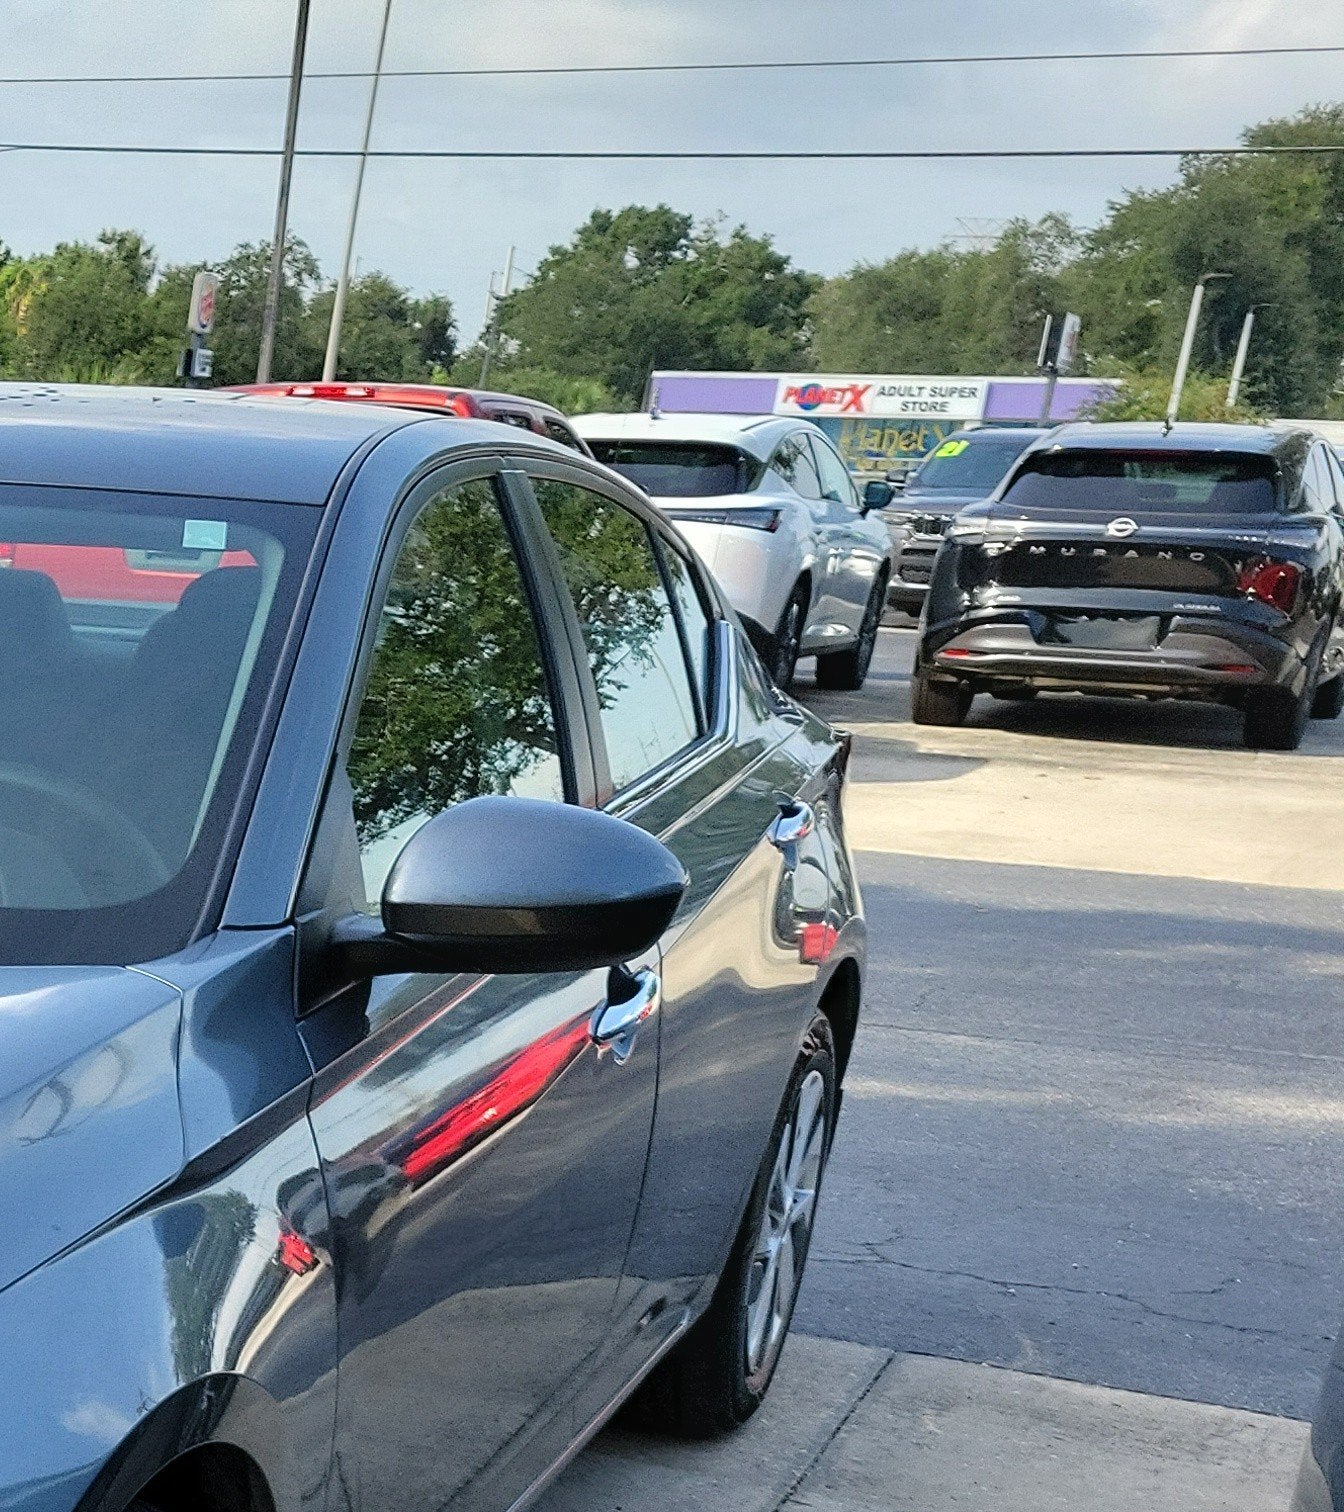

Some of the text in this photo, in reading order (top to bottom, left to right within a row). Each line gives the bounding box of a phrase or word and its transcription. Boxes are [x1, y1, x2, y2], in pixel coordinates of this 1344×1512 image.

[877, 385, 977, 398] ADULT SUPER
[901, 401, 949, 412] STORE
[936, 440, 969, 458] 21
[1029, 545, 1205, 561] MURANO
